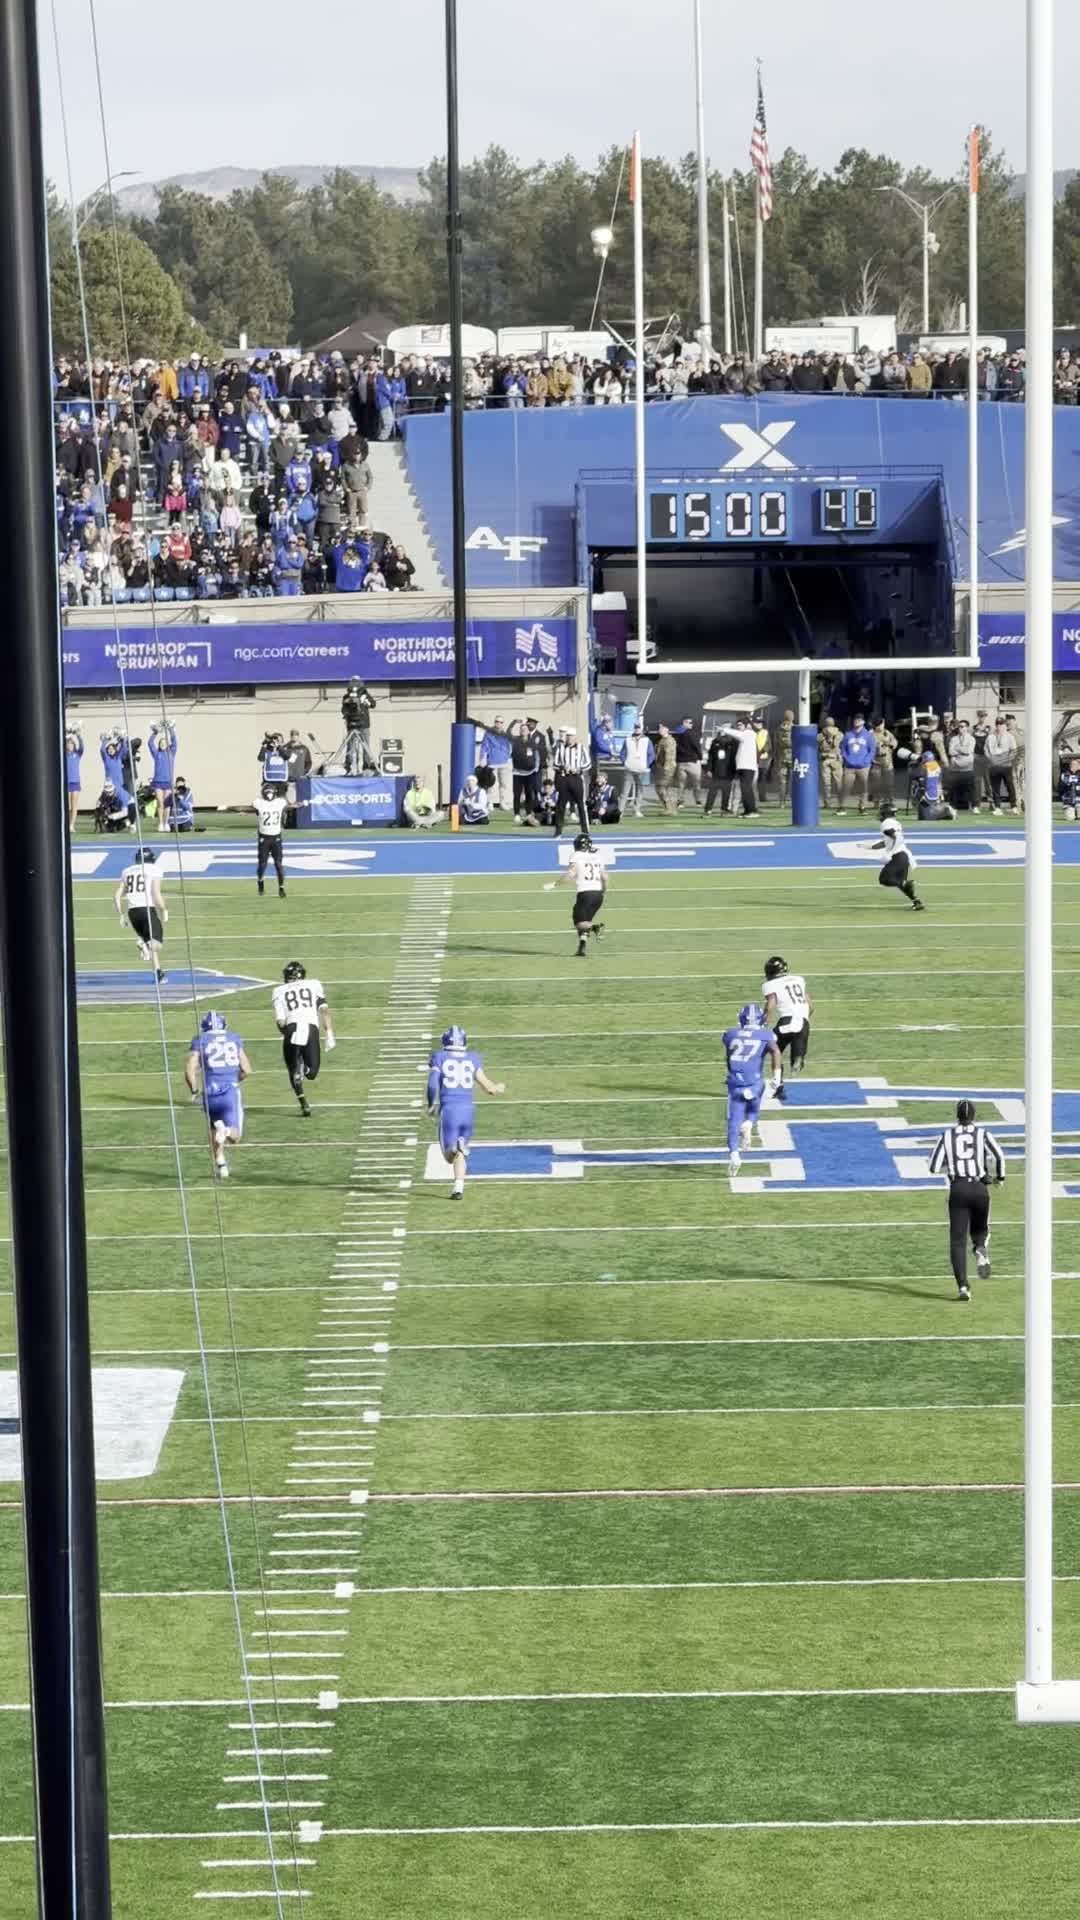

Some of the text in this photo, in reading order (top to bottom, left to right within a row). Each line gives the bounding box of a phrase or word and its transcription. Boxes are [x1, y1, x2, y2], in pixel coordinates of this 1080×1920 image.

[666, 491, 786, 537] 15:00
[825, 488, 877, 528] 40
[464, 527, 548, 561] AF
[105, 642, 187, 657] NORTHROP
[988, 635, 1025, 645] BOEI
[117, 655, 199, 670] GRUMMAN
[234, 645, 350, 661] ngc.com/careers
[385, 650, 468, 664] GRUMMA
[515, 657, 558, 673] USAA
[324, 791, 393, 805] CBS SPORTS
[126, 873, 146, 893] 86
[284, 987, 313, 1011] 89
[784, 982, 807, 1005] 19
[205, 1041, 241, 1068] 28
[729, 1038, 763, 1063] 27
[956, 1133, 975, 1160] C
